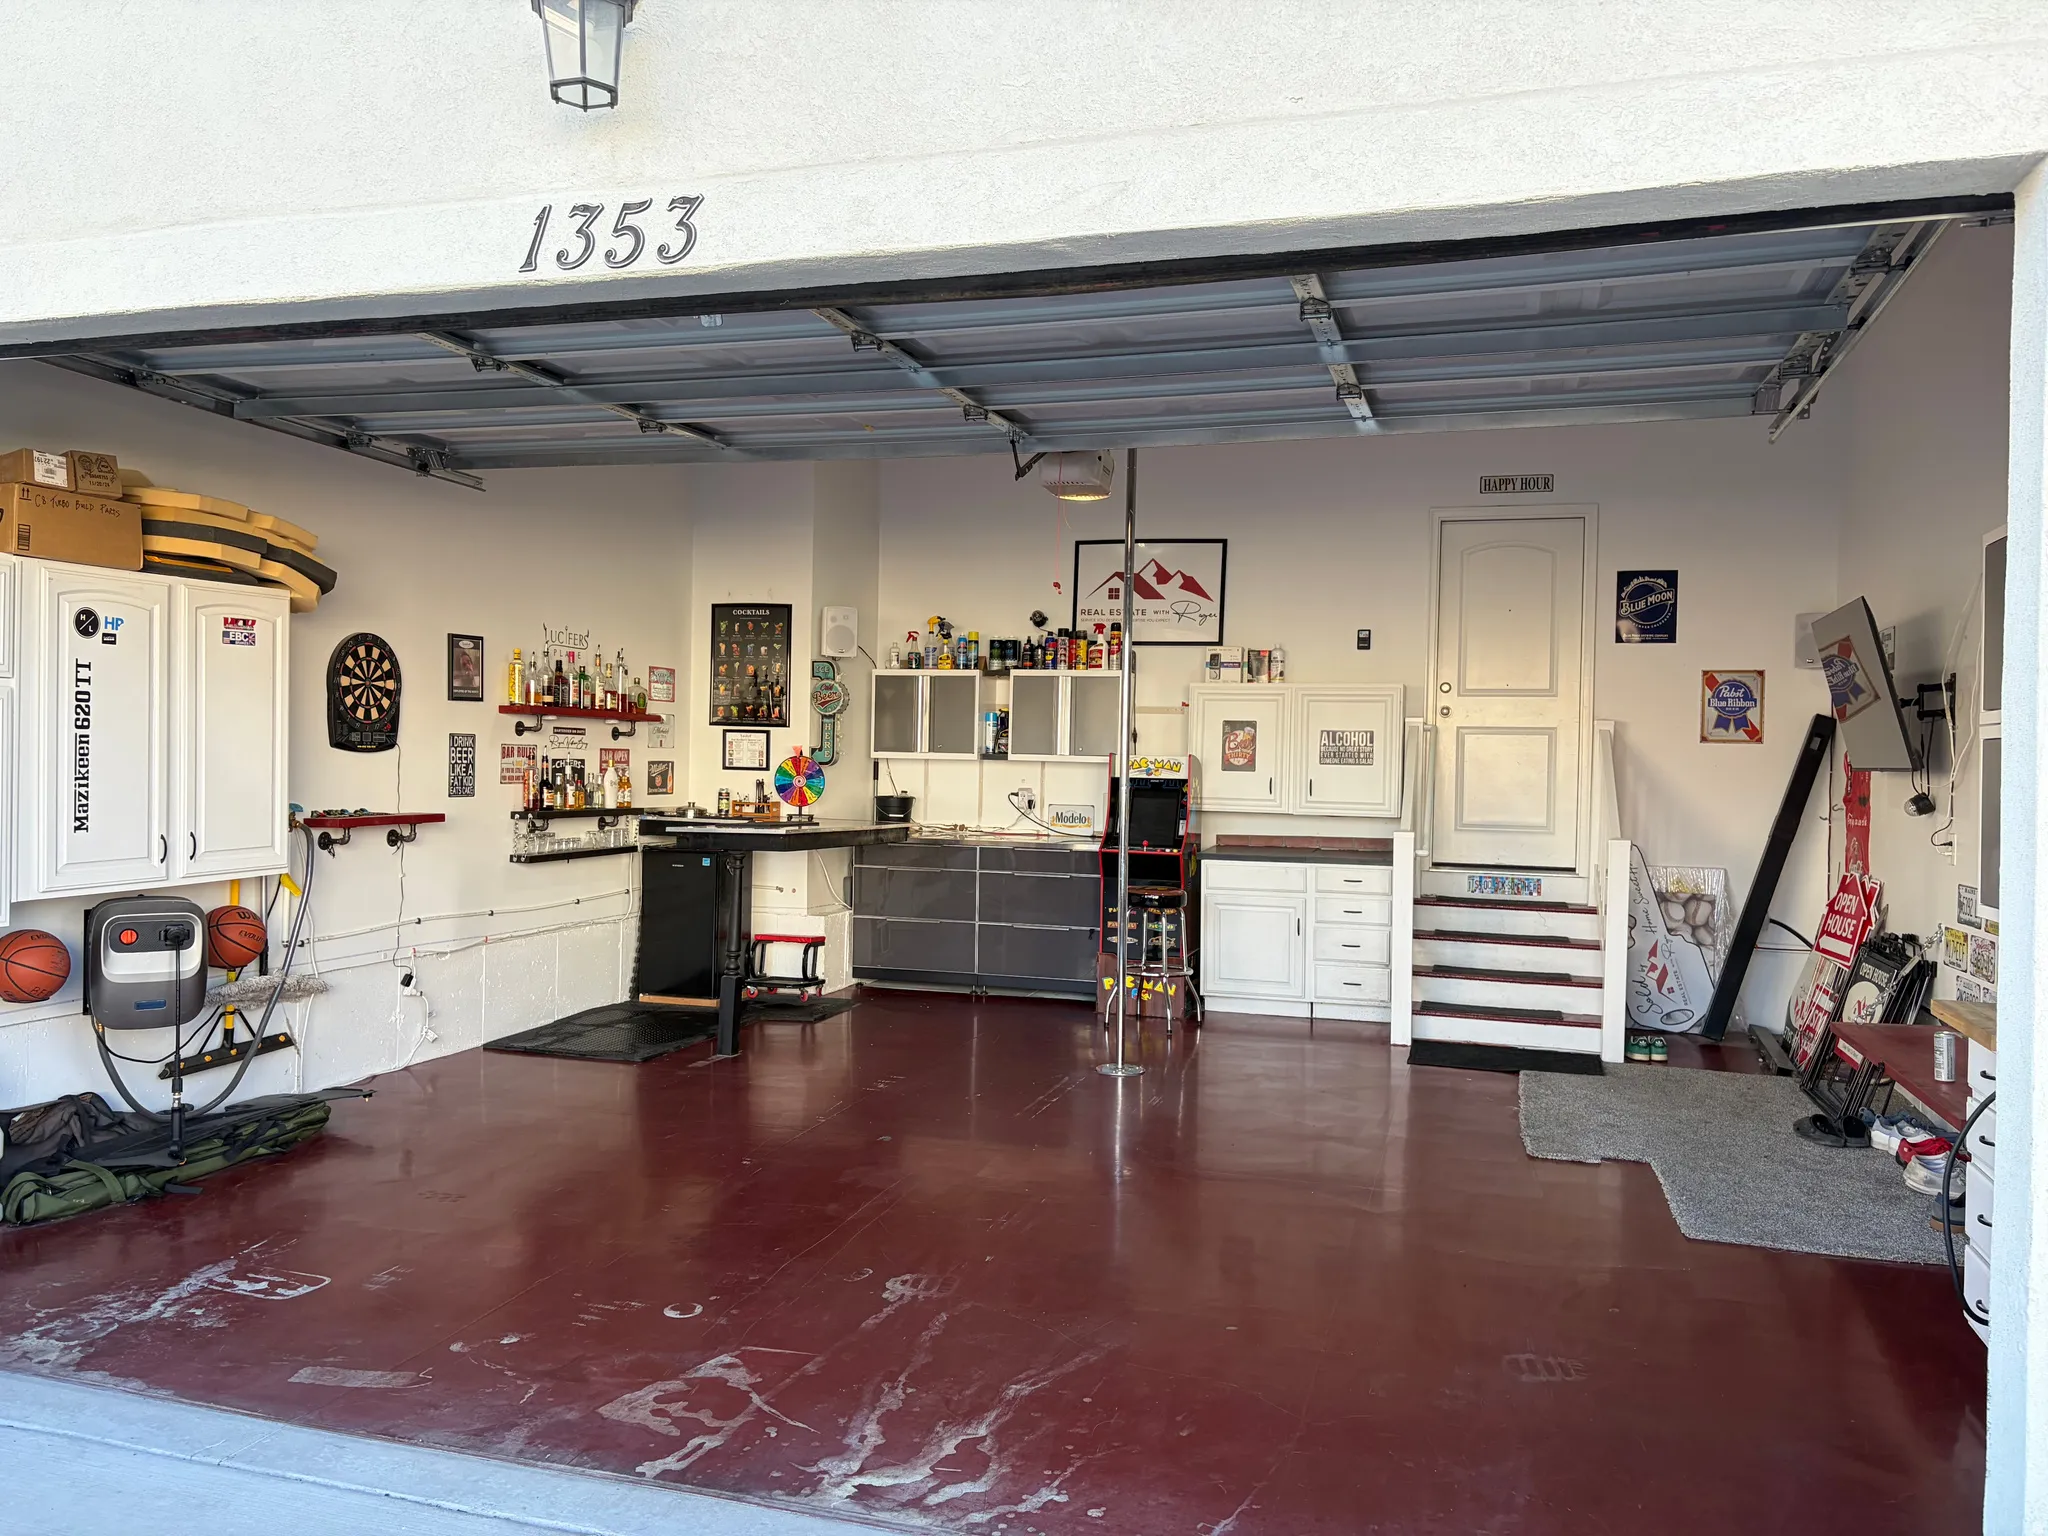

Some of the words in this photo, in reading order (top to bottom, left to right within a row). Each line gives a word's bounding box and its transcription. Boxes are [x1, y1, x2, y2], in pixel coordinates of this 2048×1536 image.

[518, 193, 705, 273] 1353
[1484, 478, 1518, 492] HAPPY
[1520, 476, 1551, 490] HOUR
[34, 494, 46, 508] C8
[50, 495, 70, 508] TURBO
[100, 504, 120, 518] PARTS
[1620, 599, 1647, 616] BLUE
[1647, 590, 1673, 606] MOON
[104, 616, 124, 630] HP
[230, 632, 249, 642] EBC
[554, 649, 582, 660] PLAE
[75, 658, 92, 688] TT
[812, 690, 838, 703] Beer
[1719, 686, 1746, 698] Pabst
[74, 690, 91, 730] 620
[1710, 698, 1726, 707] Blue
[1728, 698, 1755, 707] Ribbon
[454, 736, 474, 747] DRINK
[1321, 732, 1373, 746] ALCOHOL
[450, 747, 474, 764] BEER
[502, 746, 514, 759] BAR
[517, 746, 536, 759] RULES
[601, 750, 613, 761] BAR
[614, 751, 628, 761] OPEN
[450, 764, 466, 776] LIKE
[468, 764, 473, 776] A
[74, 732, 90, 834] Mazikeen
[450, 776, 462, 786] FAT
[463, 776, 474, 787] KID
[450, 786, 461, 794] EATS
[1056, 812, 1087, 824] Modelo
[1630, 874, 1650, 906] Sweet
[1834, 892, 1860, 916] OPEN
[1641, 908, 1658, 934] Home
[1824, 913, 1857, 939] HOUSE
[1673, 970, 1684, 991] ESTATE
[1632, 974, 1664, 1015] Sold
